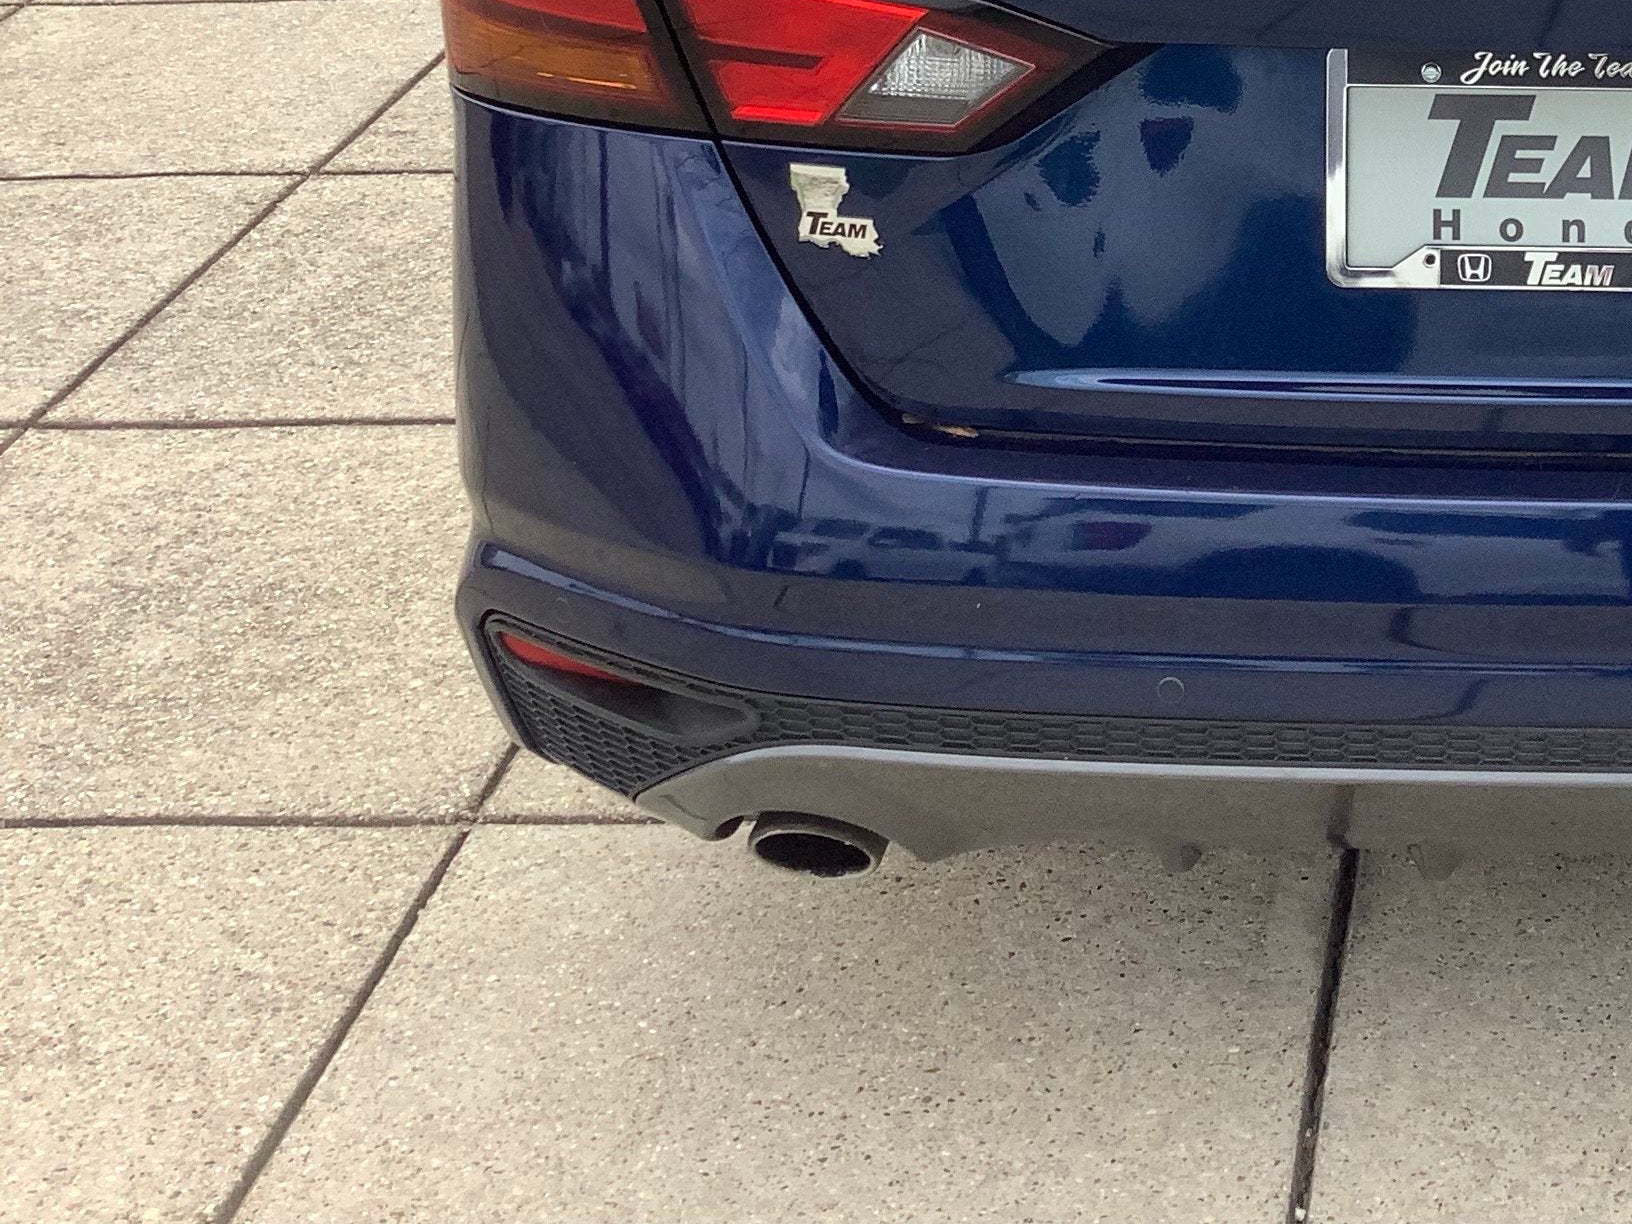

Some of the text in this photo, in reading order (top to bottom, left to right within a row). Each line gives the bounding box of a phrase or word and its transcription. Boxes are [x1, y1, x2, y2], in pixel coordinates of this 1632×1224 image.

[1460, 51, 1529, 85] Join
[1533, 52, 1585, 78] The
[807, 211, 868, 239] TEAM
[1524, 252, 1614, 286] TEAM
